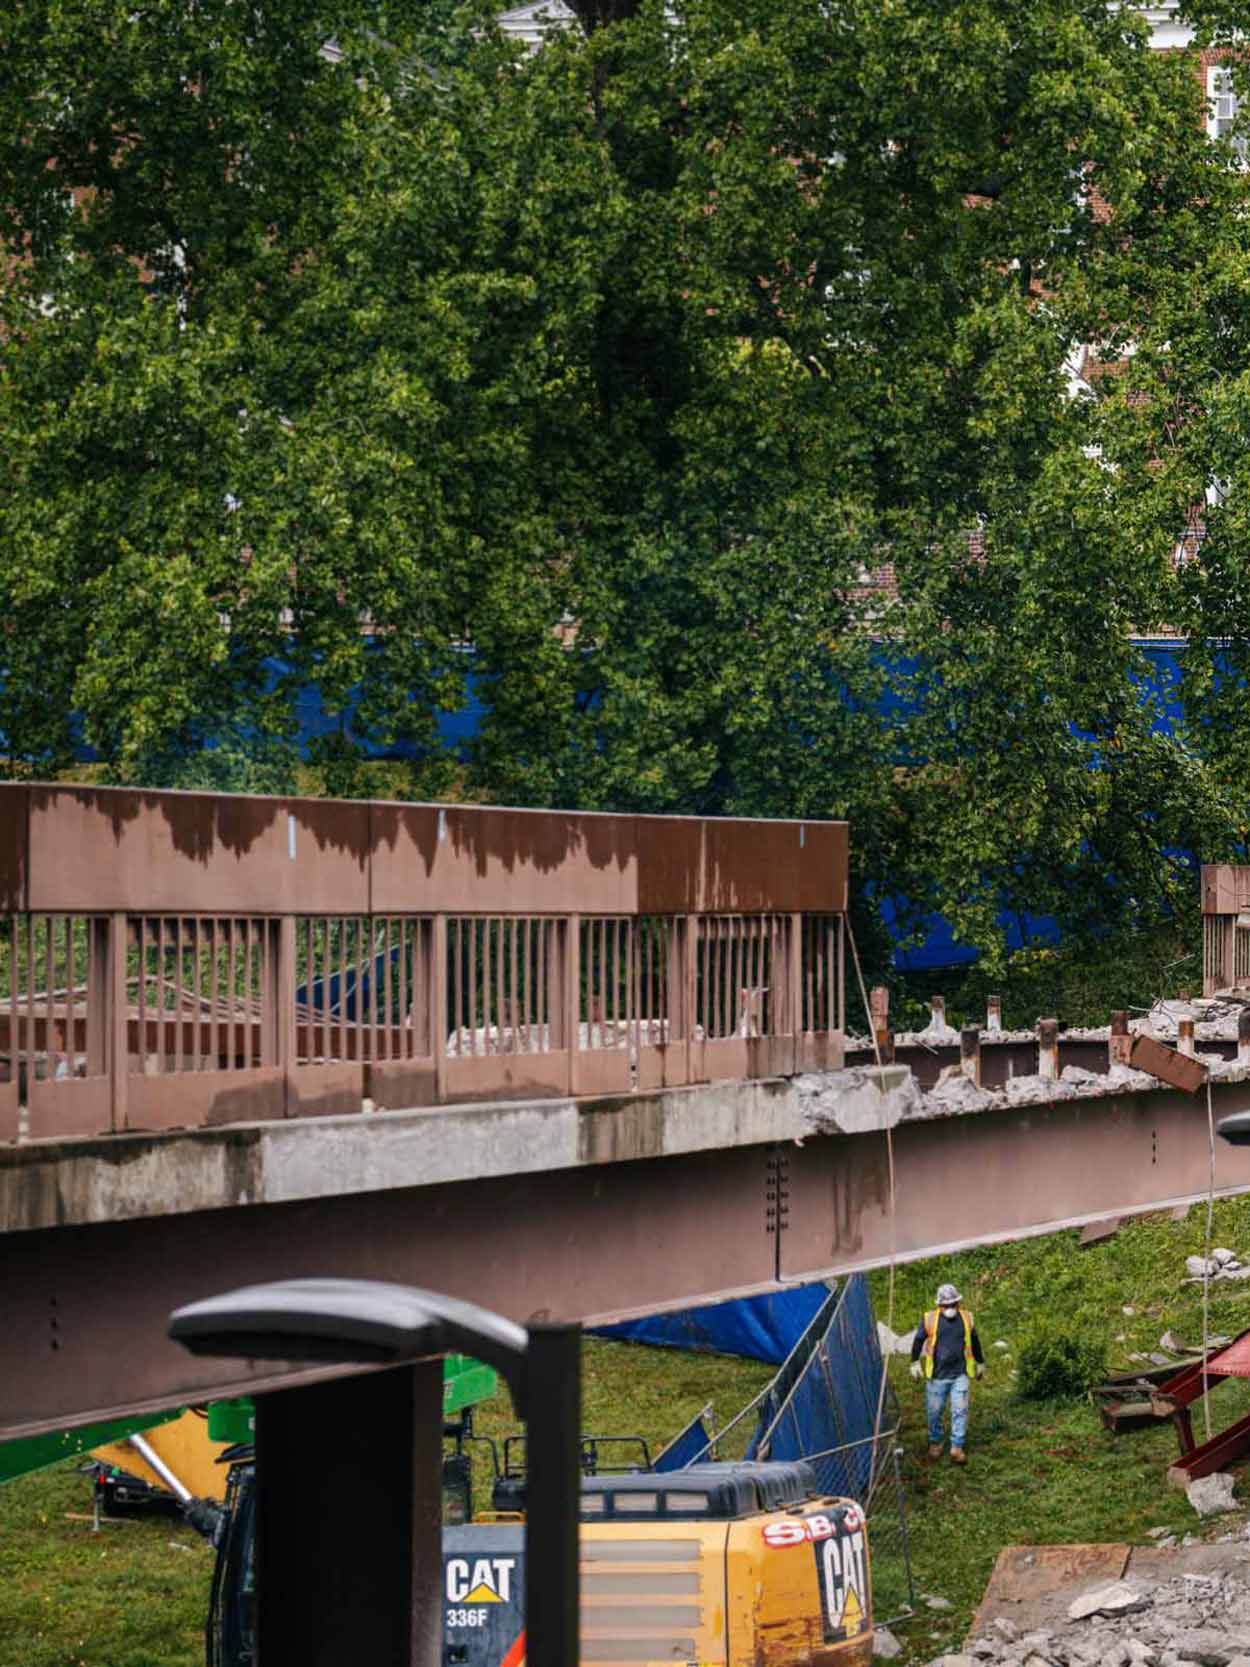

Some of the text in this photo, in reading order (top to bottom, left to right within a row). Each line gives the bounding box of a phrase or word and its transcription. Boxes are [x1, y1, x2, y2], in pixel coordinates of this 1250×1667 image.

[446, 1558, 516, 1603] CAT
[823, 1531, 868, 1629] CAT
[447, 1608, 488, 1628] 336F
